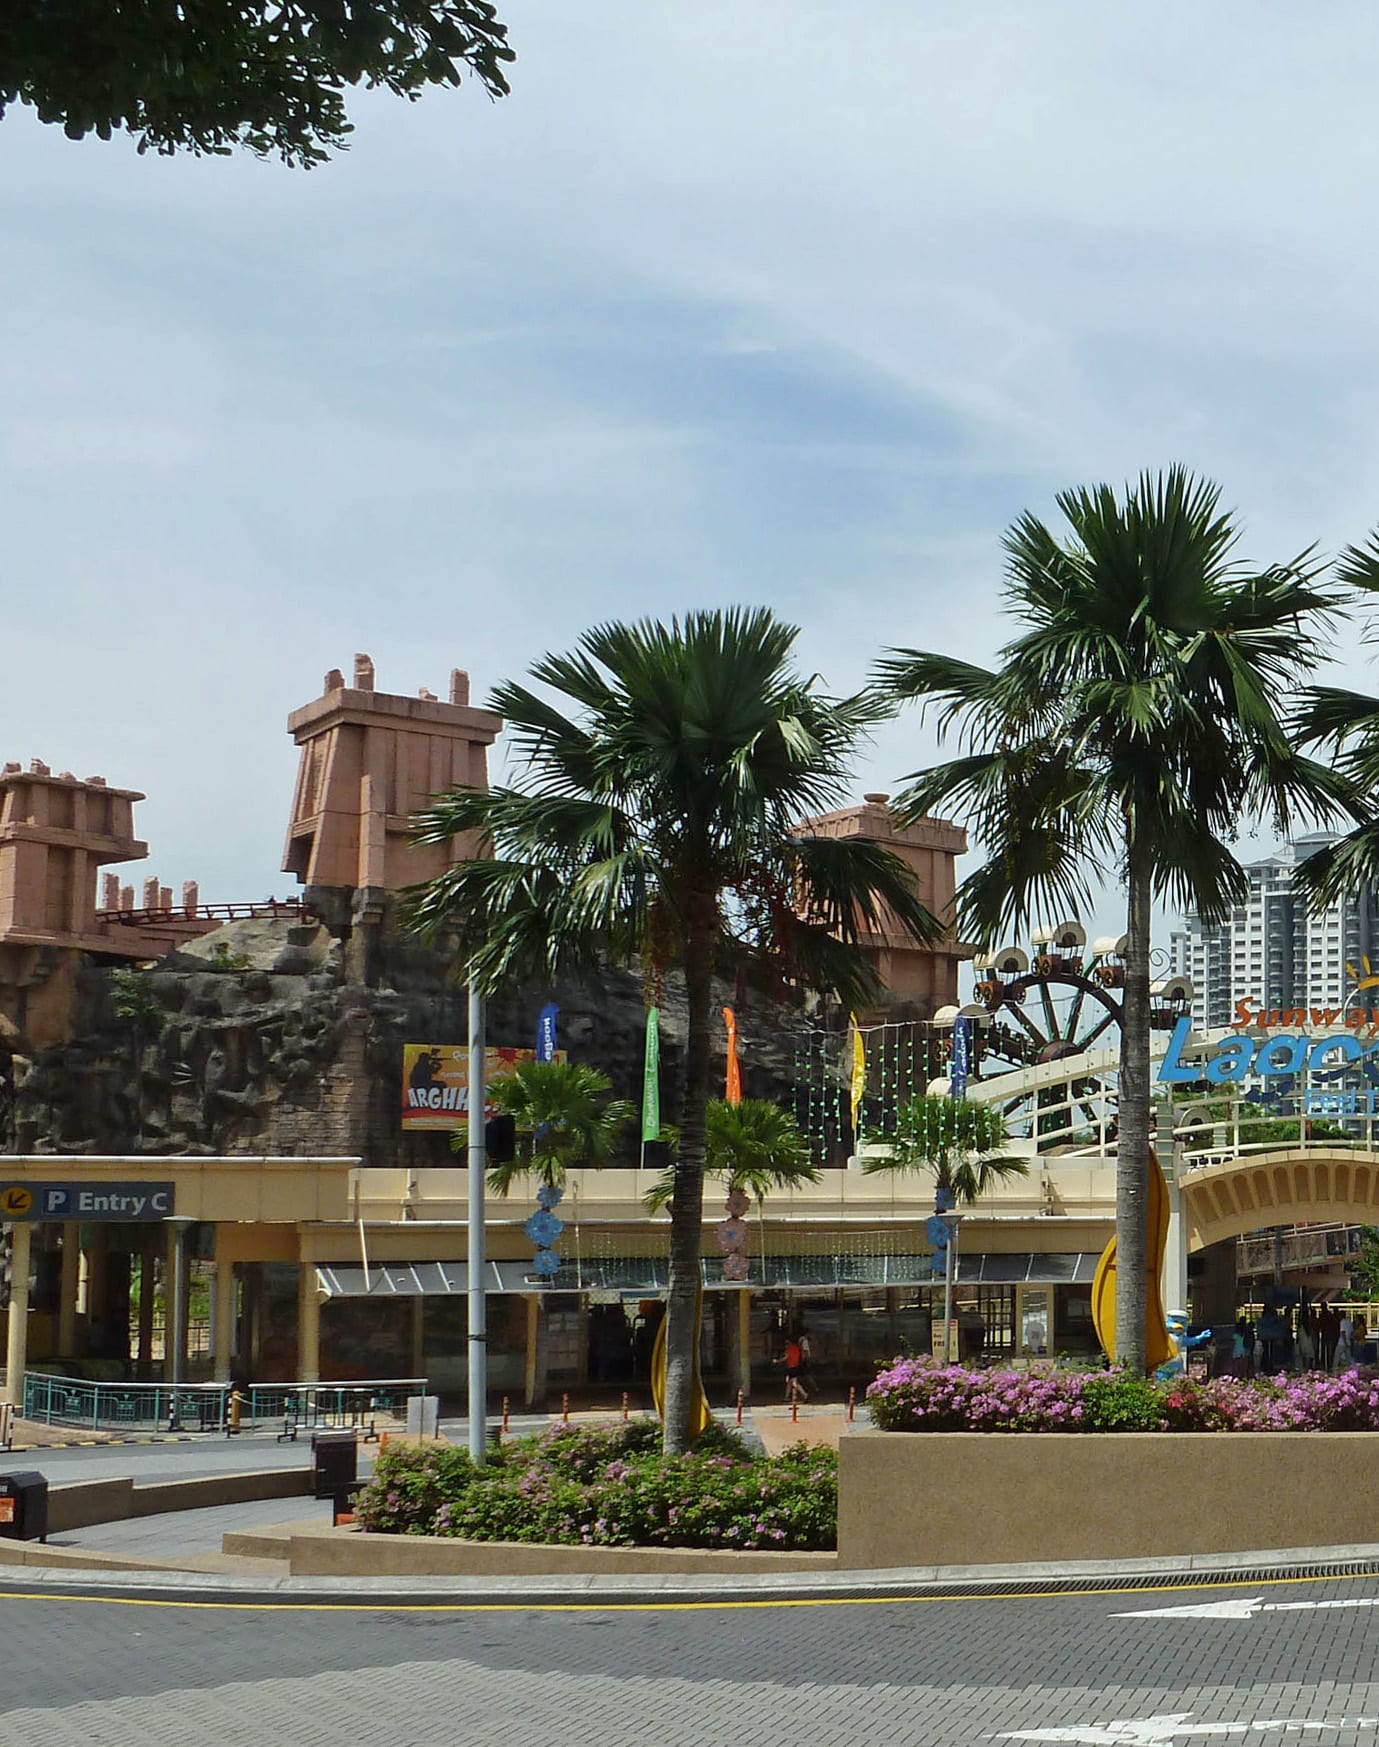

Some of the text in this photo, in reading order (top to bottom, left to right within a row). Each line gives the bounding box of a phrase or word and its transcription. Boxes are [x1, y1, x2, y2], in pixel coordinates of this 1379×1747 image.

[543, 1018, 554, 1061] agoon
[1305, 1087, 1356, 1112] Feel
[48, 1190, 168, 1215] P Entry C
